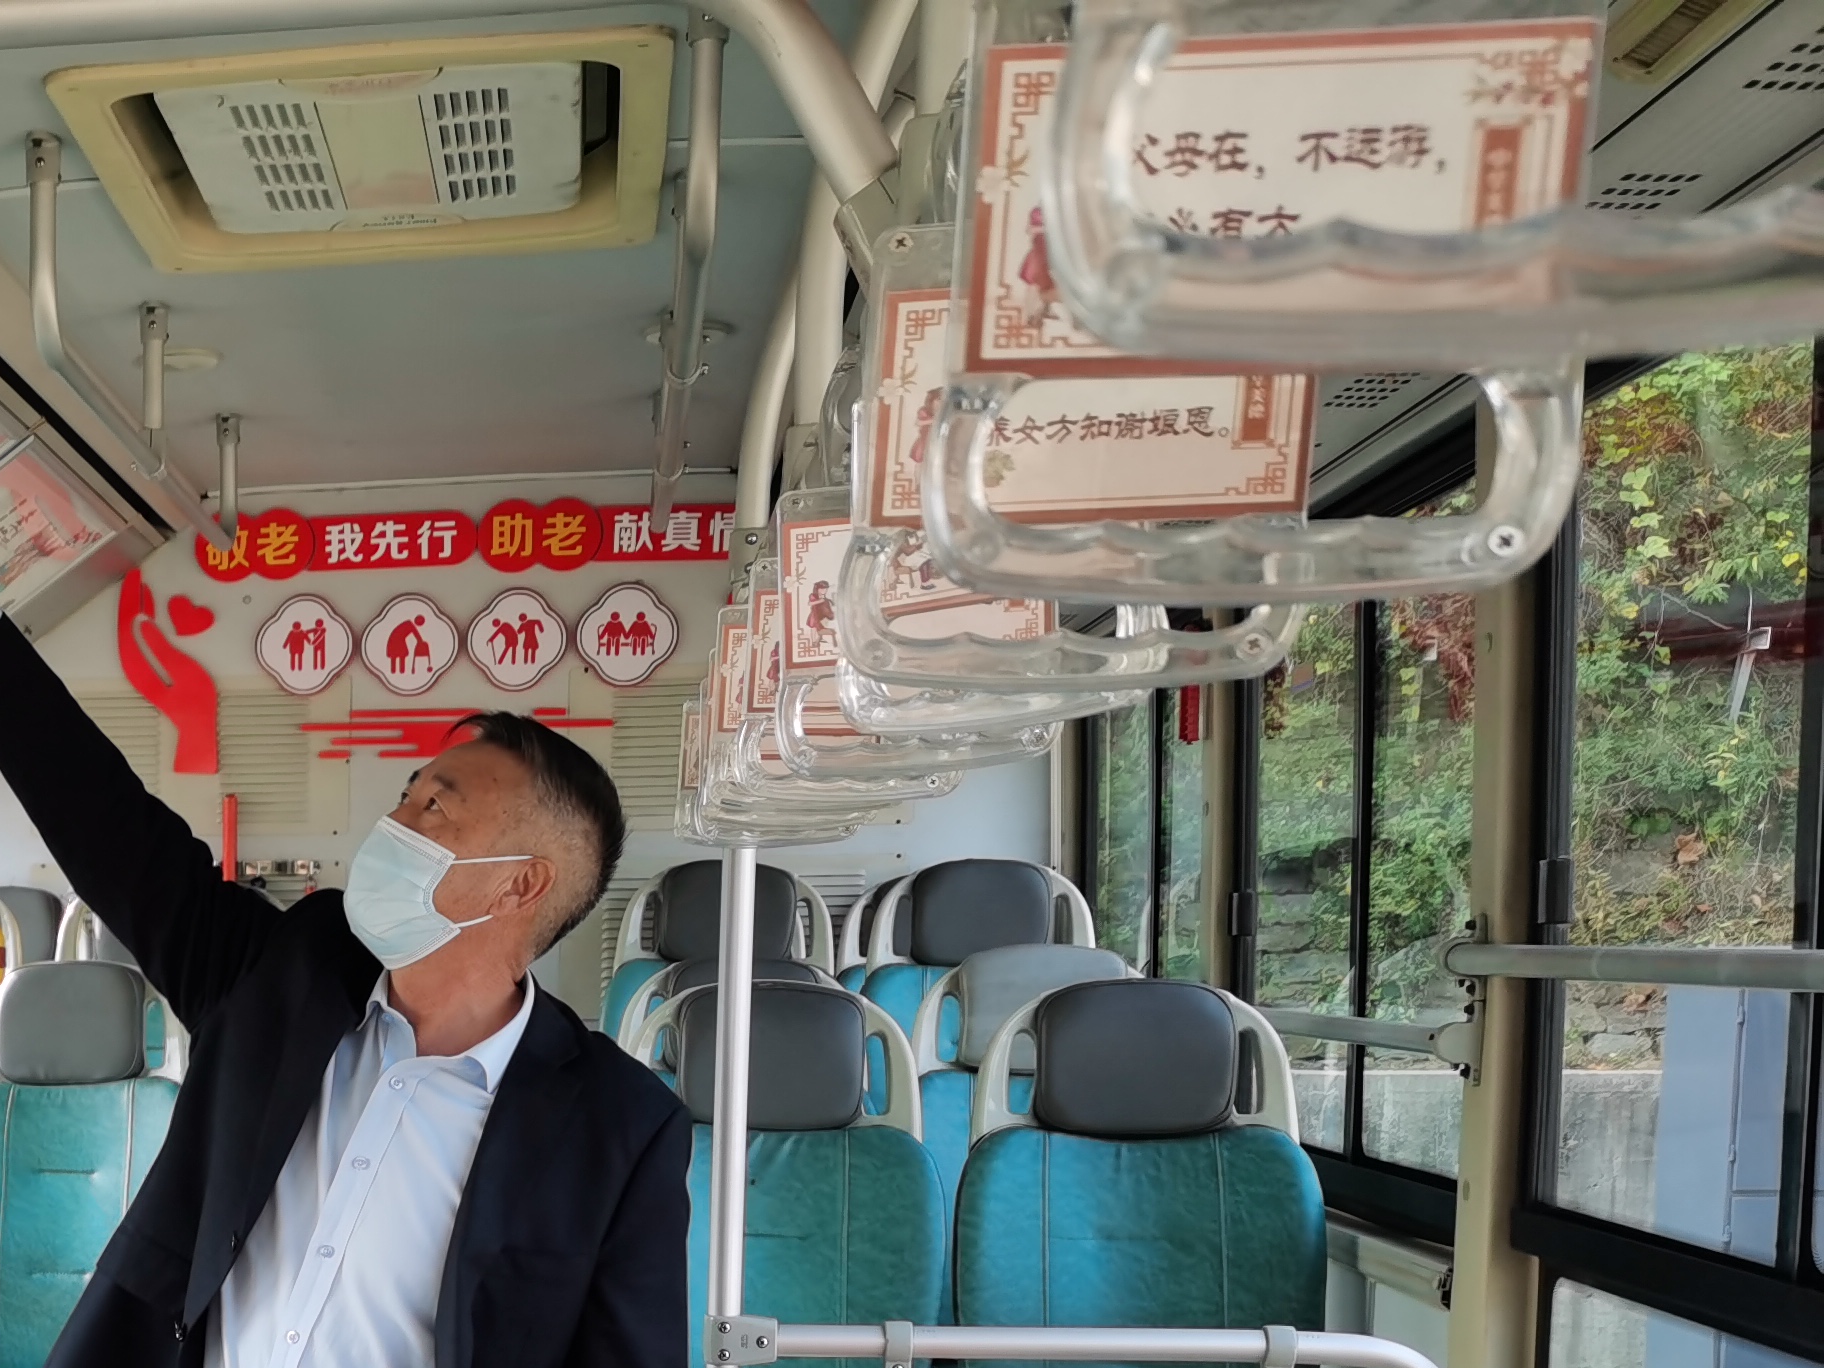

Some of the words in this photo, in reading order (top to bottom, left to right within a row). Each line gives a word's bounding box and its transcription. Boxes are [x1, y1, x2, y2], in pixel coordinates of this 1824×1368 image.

[325, 520, 458, 564] 我先行
[490, 512, 586, 558] 助老
